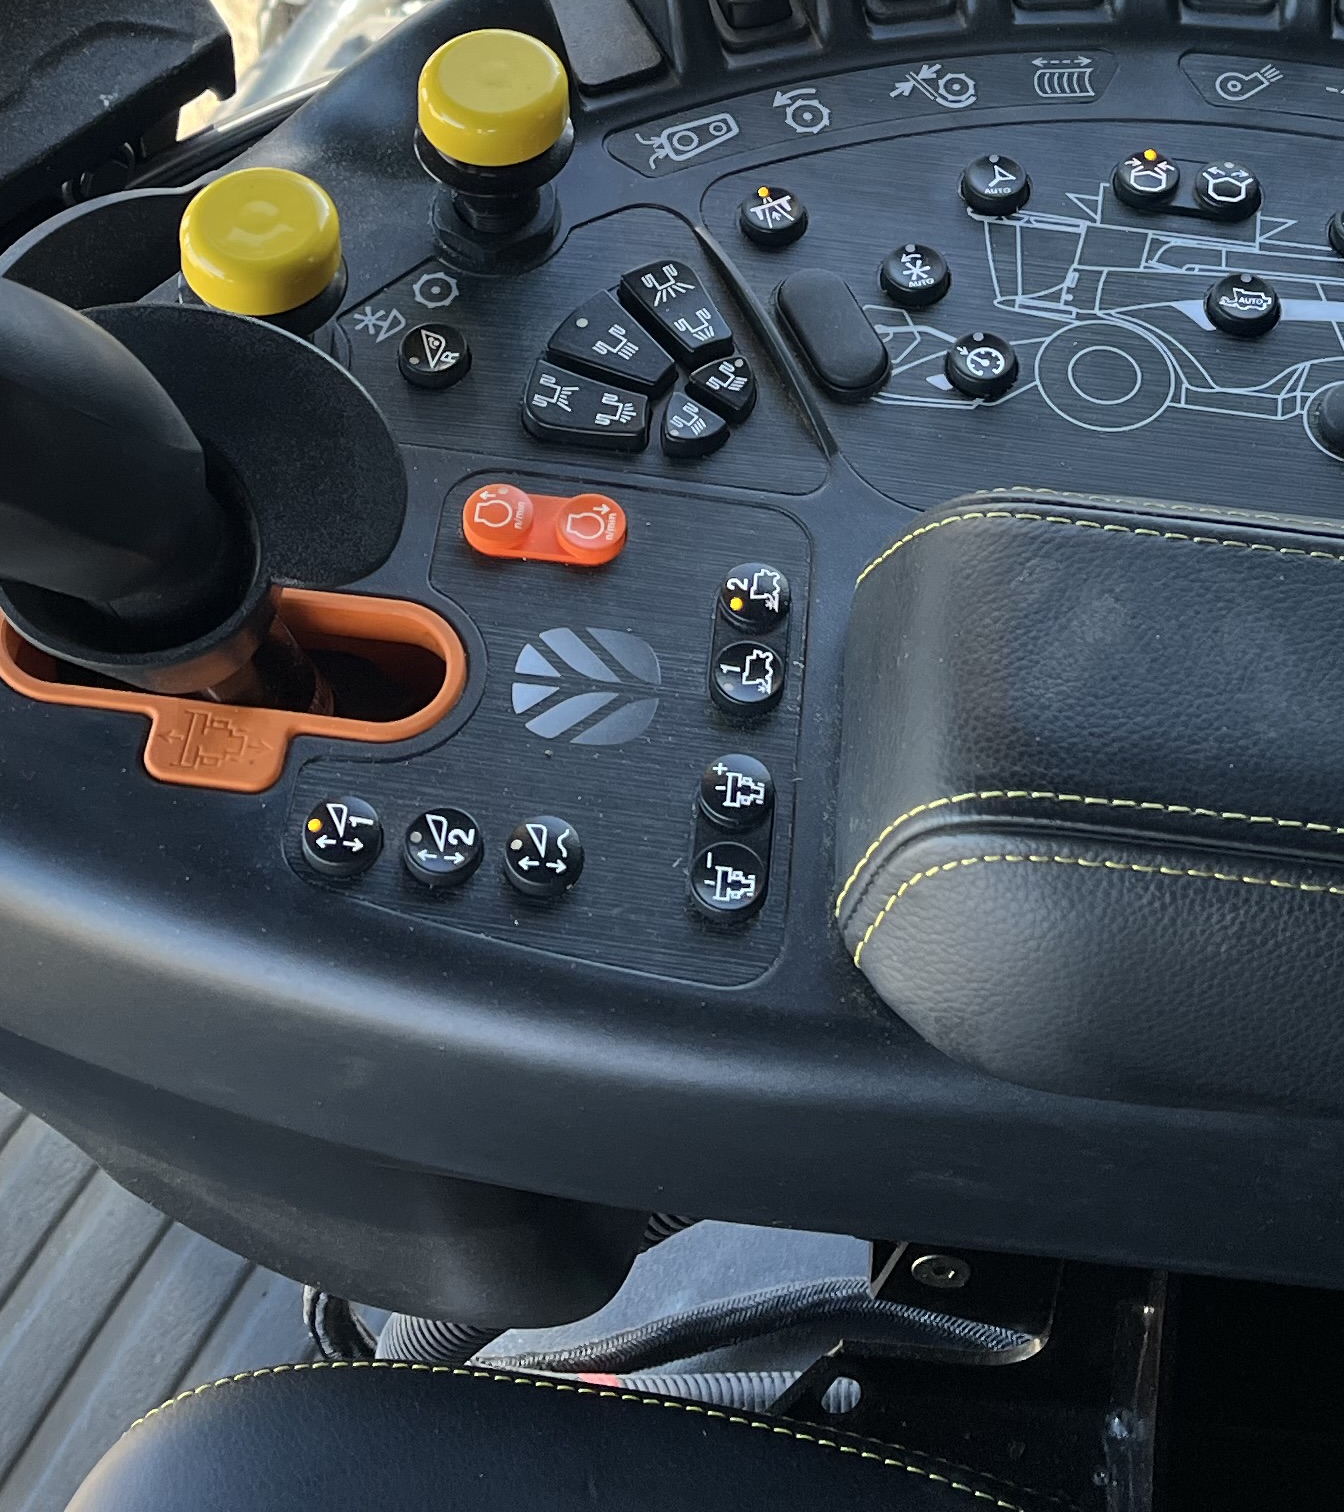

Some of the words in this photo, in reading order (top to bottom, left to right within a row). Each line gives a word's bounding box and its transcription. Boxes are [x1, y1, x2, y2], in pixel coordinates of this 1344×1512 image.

[908, 277, 935, 288] AUTO
[1238, 296, 1264, 305] AUTO
[440, 351, 460, 363] R
[514, 501, 526, 530] n/min
[605, 512, 617, 541] n/min
[726, 577, 749, 591] 2
[719, 663, 741, 674] 1
[348, 815, 374, 827] 1
[447, 828, 476, 846] 2
